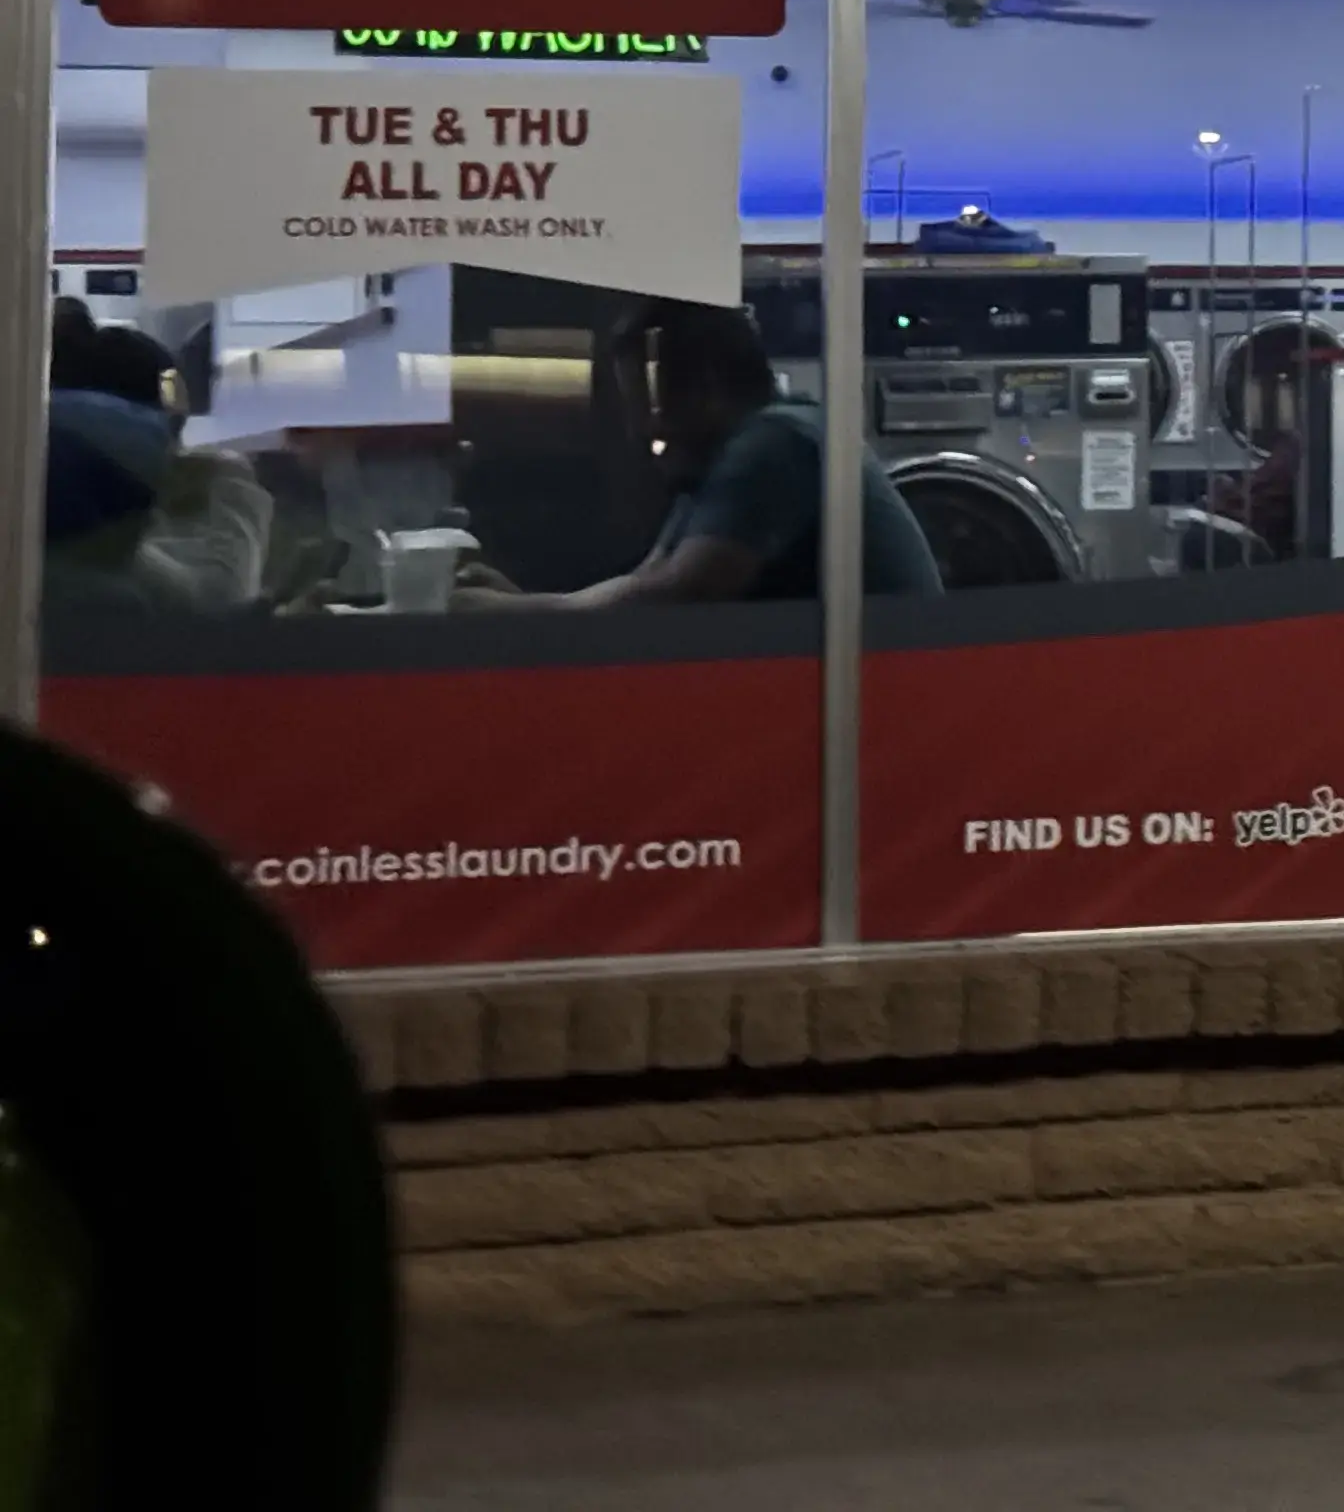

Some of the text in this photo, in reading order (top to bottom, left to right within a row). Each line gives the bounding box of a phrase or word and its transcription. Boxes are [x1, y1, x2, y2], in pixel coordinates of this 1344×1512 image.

[311, 106, 589, 147] TUE & THU
[341, 161, 557, 200] ALL DAY
[283, 217, 357, 238] COLD
[364, 217, 449, 238] WATER
[456, 218, 530, 239] WASH
[964, 818, 1062, 853] FIND
[1074, 814, 1131, 849] US
[1143, 811, 1215, 846] ON:
[1233, 802, 1320, 848] yelp
